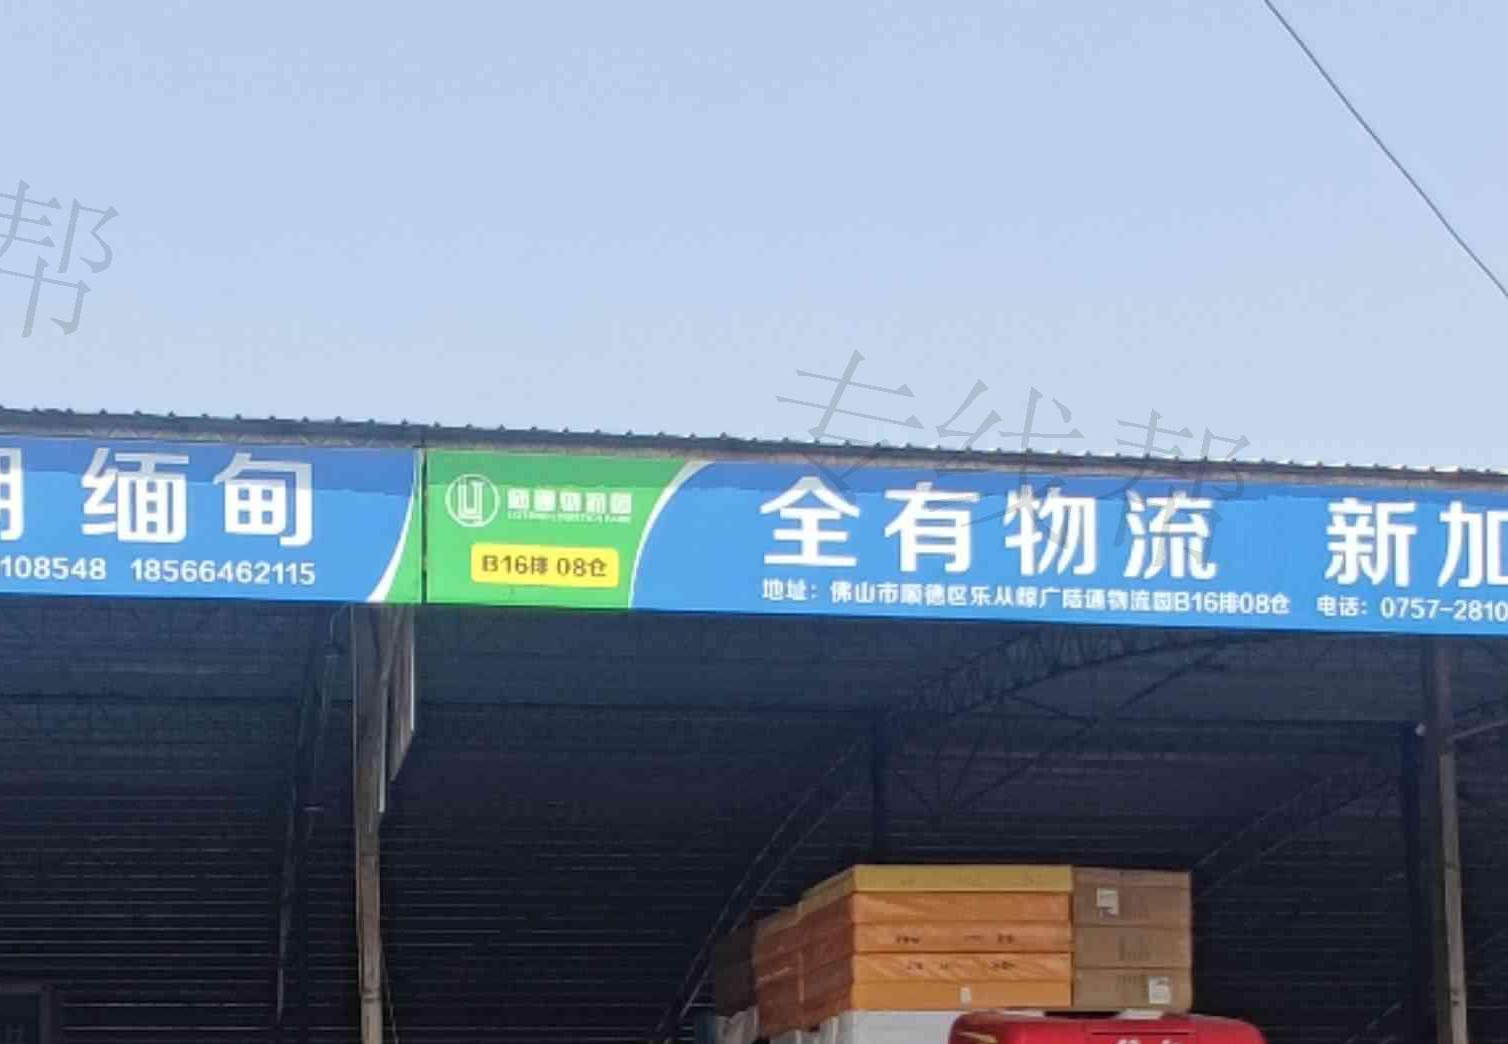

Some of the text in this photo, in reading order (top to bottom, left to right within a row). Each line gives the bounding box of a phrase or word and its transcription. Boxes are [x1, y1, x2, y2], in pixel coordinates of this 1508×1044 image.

[81, 448, 313, 547] 缅甸
[760, 476, 1217, 580] 全有物流
[130, 560, 316, 586] 18566462115
